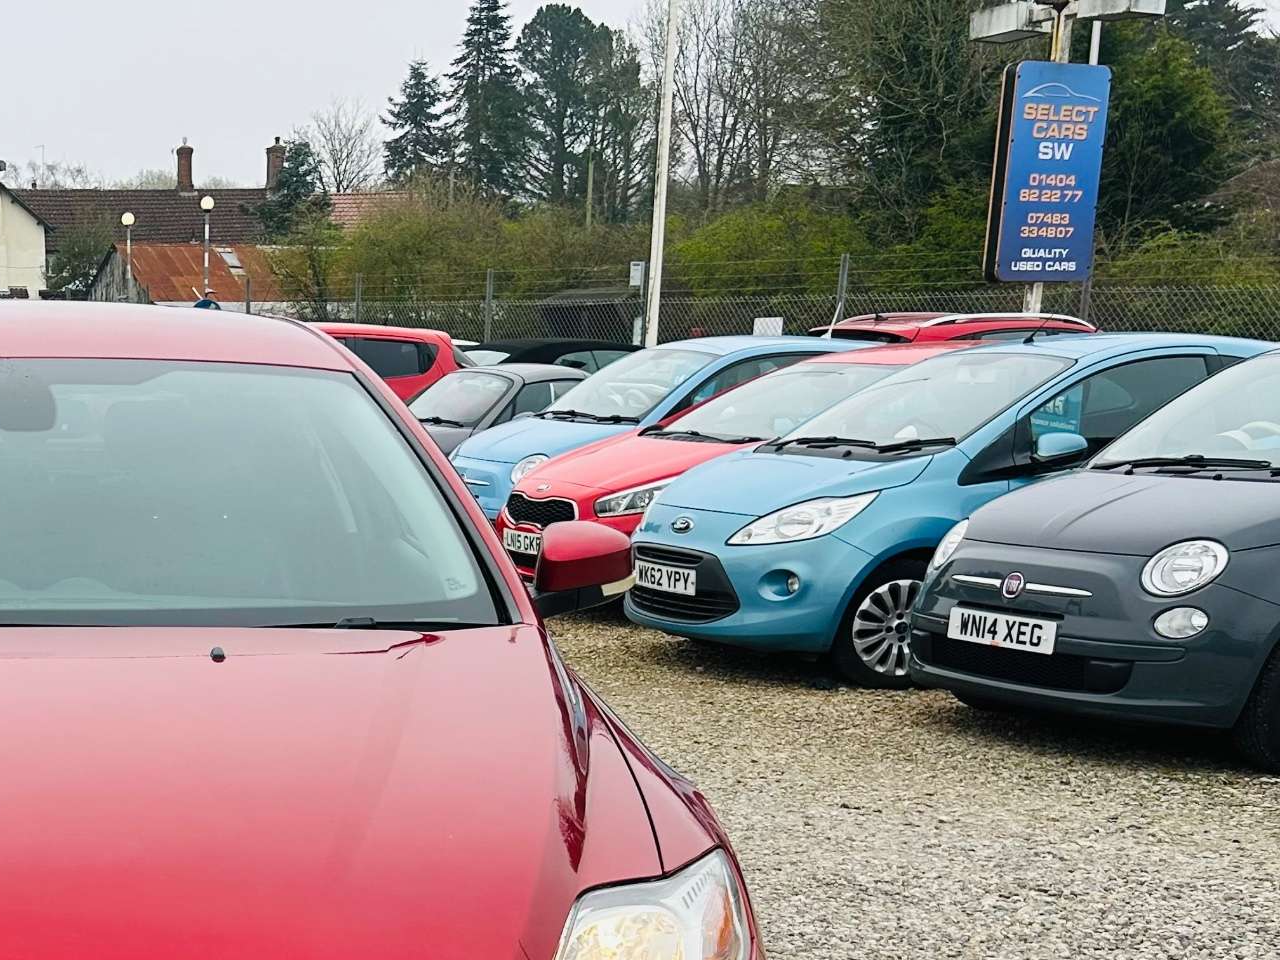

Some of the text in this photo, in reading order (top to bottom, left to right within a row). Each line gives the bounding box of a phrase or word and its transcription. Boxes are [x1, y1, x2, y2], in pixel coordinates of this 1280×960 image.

[1023, 103, 1099, 122] SELECT
[1032, 122, 1088, 140] CARS
[1038, 141, 1073, 160] SW
[1029, 173, 1076, 187] 01404
[1027, 213, 1069, 225] 07483
[1020, 226, 1074, 238] 334807
[1021, 247, 1069, 258] QUALITY
[1011, 261, 1077, 271] USED CARS
[506, 531, 522, 549] LN15
[638, 564, 690, 591] WK62 YPY
[960, 612, 1043, 647] WN14 XEG
